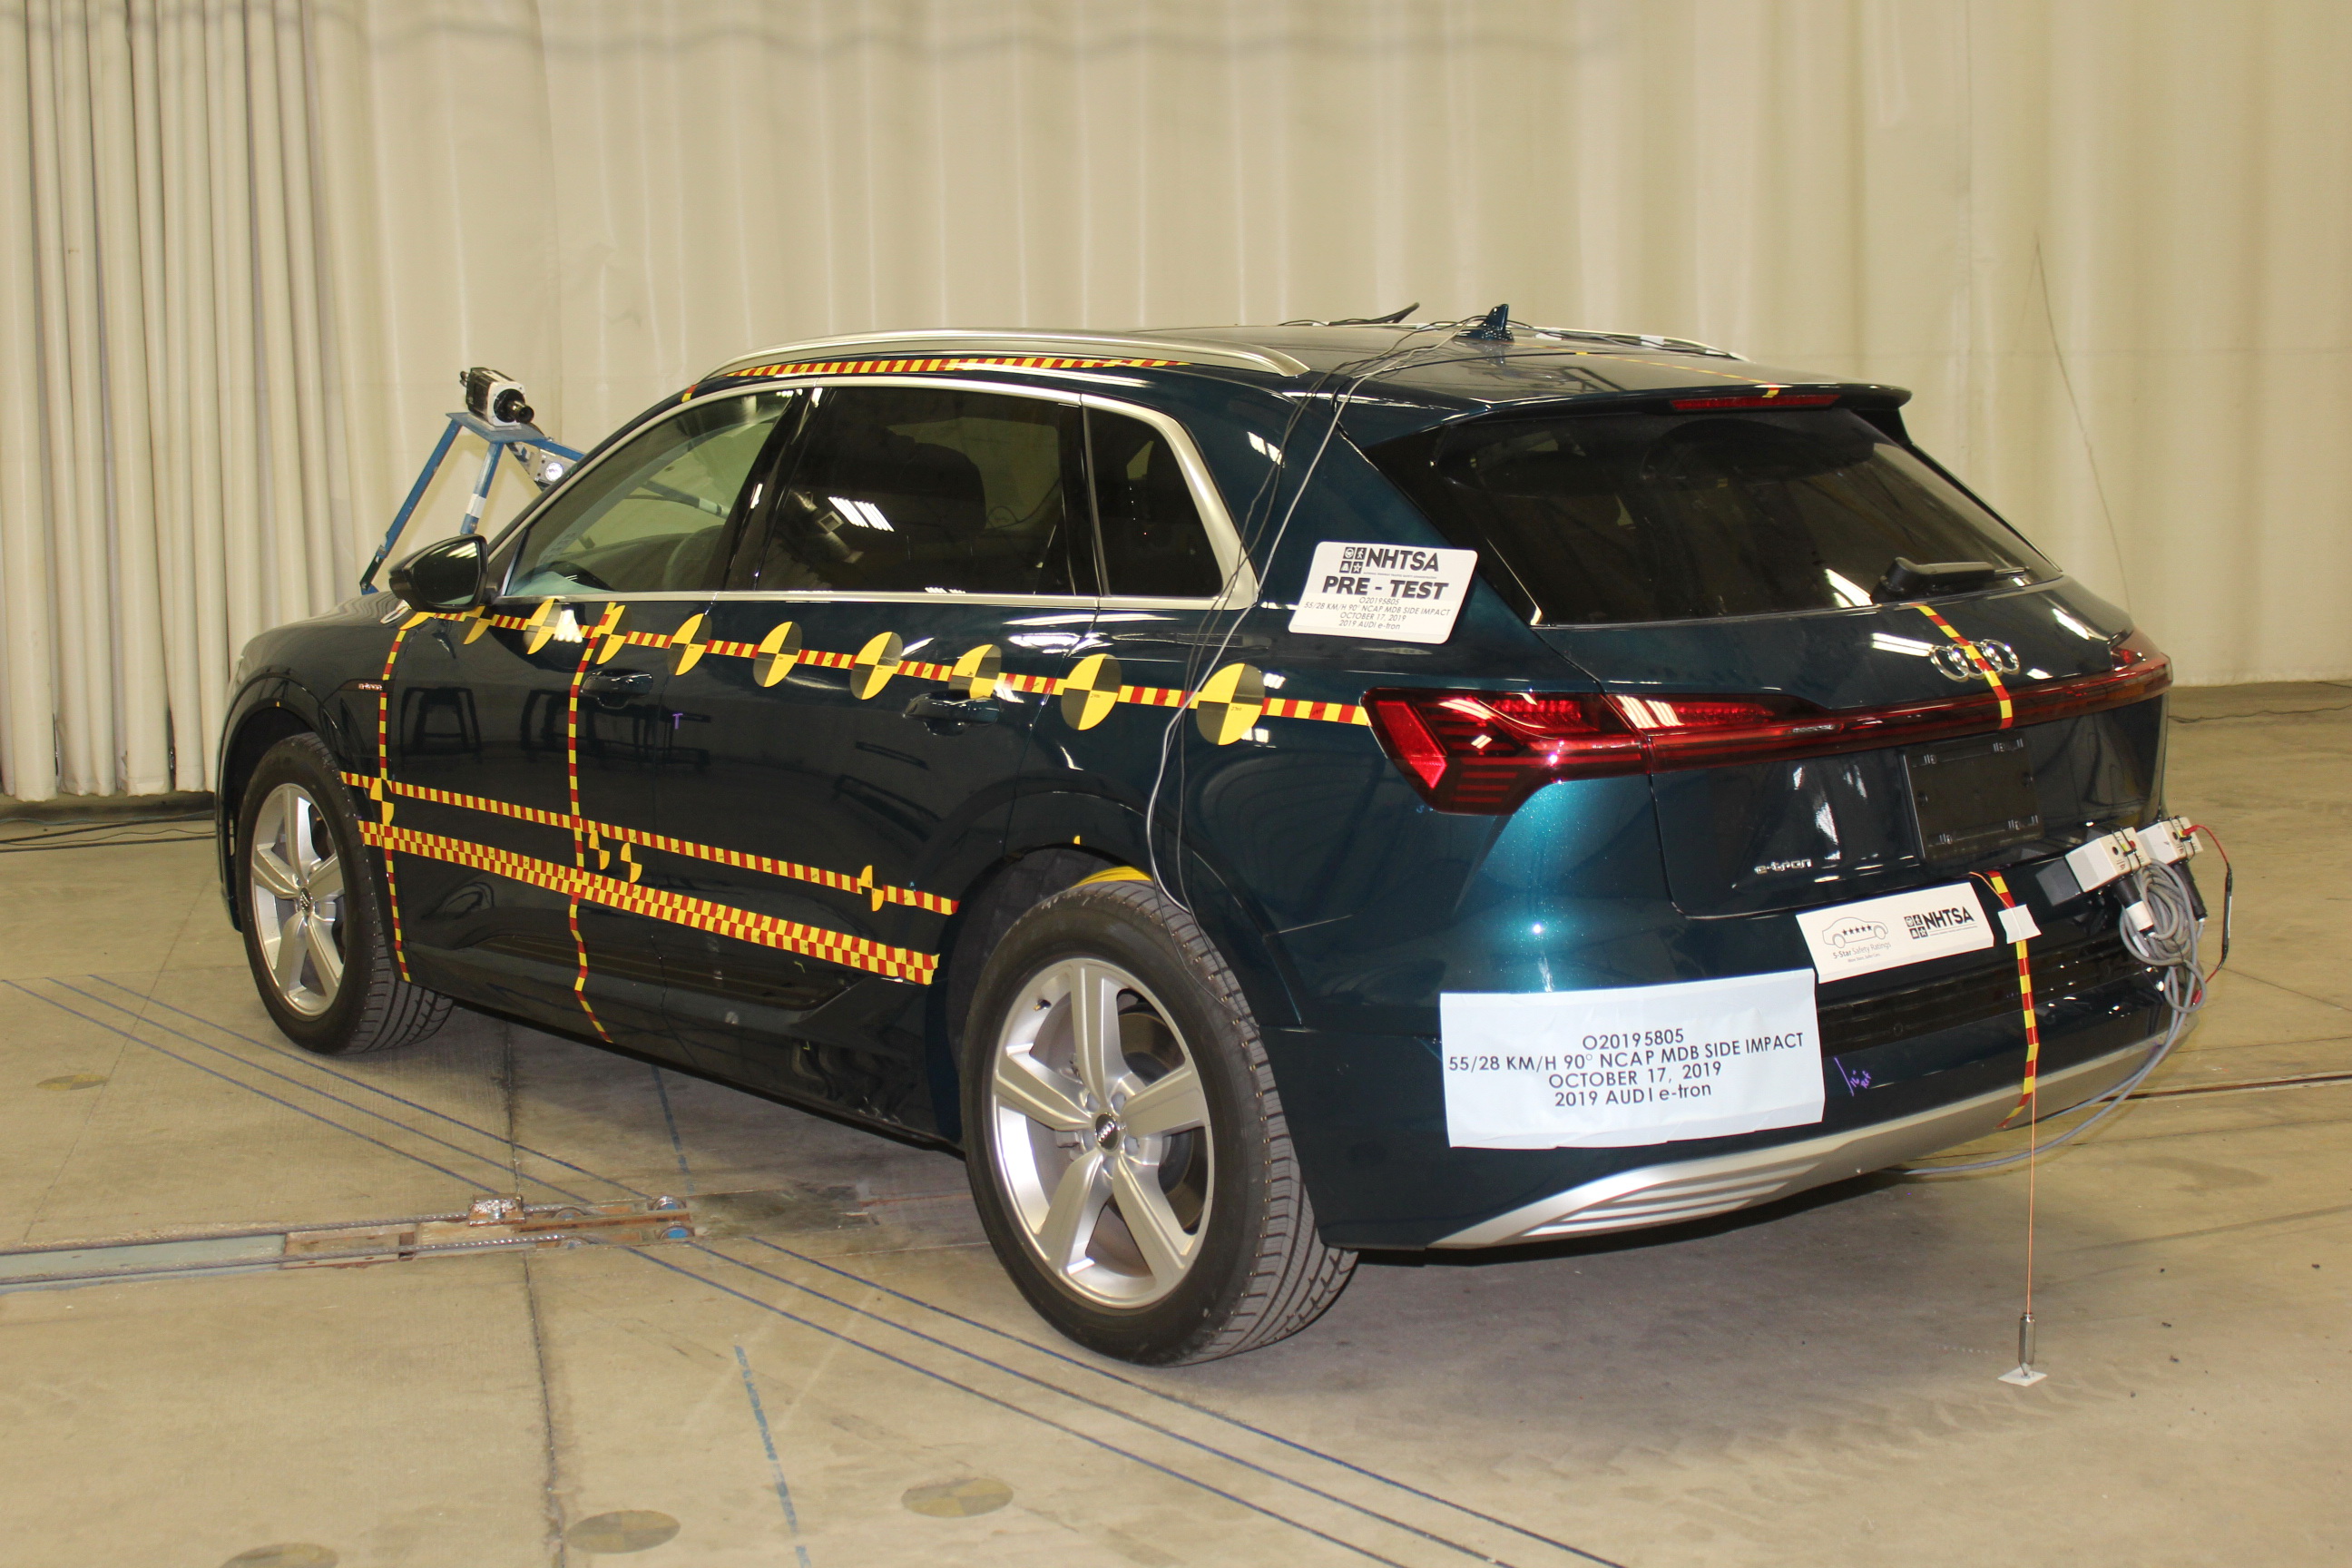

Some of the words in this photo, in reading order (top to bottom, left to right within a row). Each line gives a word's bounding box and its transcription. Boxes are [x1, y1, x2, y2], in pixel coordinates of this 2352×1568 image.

[1366, 547, 1439, 572] NHTSA
[1322, 575, 1371, 596] PRE
[1390, 579, 1449, 600] TEST
[1304, 602, 1326, 610] 55/28
[1326, 603, 1347, 611] KM/H
[1361, 604, 1384, 612] NCAP
[1420, 608, 1451, 616] IMPACT
[1340, 612, 1375, 620] OCTOBER
[1338, 619, 1357, 627] 2019
[1377, 622, 1401, 630] e-tron
[1754, 858, 1812, 875] e-tron
[1921, 906, 1975, 930] NHTSA
[1832, 950, 1852, 959] 5-Star
[1852, 946, 1870, 955] Safety
[1870, 942, 1892, 951] Ratings
[1448, 1055, 1500, 1073] 55/28
[1506, 1055, 1557, 1073] KM/H
[1600, 1050, 1655, 1068] NCAP
[1661, 1045, 1700, 1063] MDB
[1705, 1040, 1741, 1059] SIDE
[1745, 1032, 1804, 1054] IMPACT
[1548, 1070, 1638, 1089] OCTOBER
[1648, 1067, 1672, 1083] 17,
[1682, 1061, 1722, 1080] 2019
[1554, 1090, 1599, 1107] 2019
[1605, 1087, 1654, 1105] AUDI
[1659, 1083, 1711, 1101] e-tron
